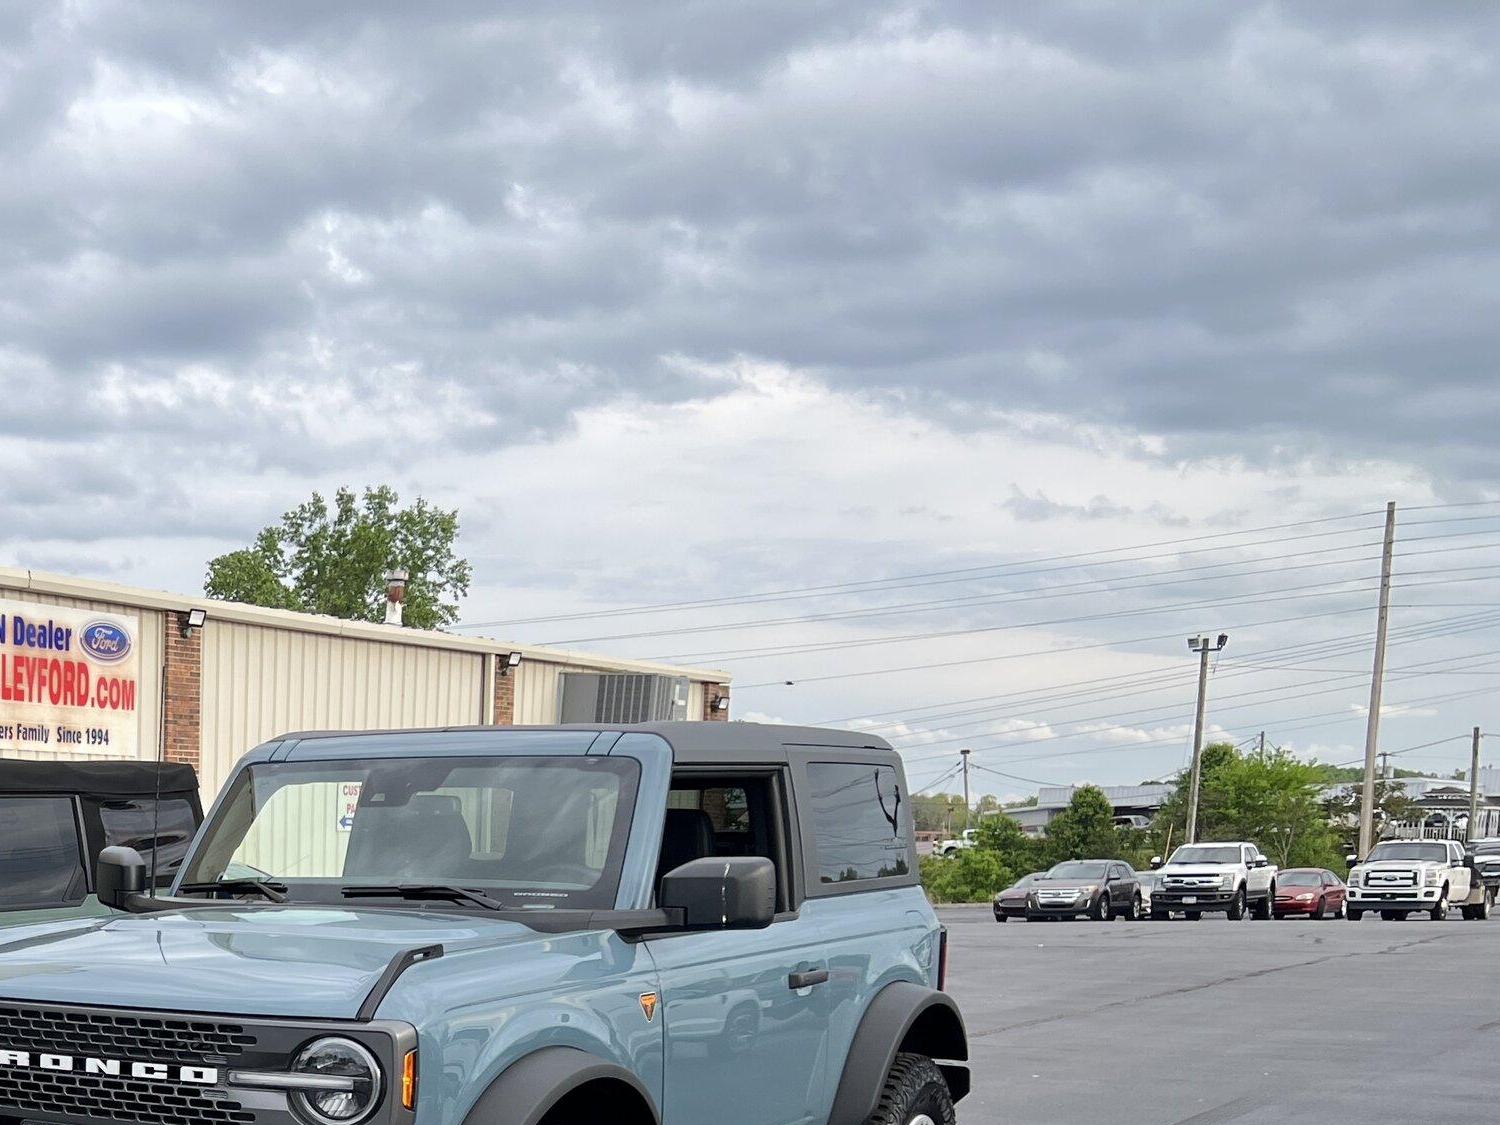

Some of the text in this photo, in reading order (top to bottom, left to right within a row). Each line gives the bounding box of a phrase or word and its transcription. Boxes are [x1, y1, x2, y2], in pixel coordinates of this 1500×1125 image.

[13, 616, 73, 651] Dealer
[91, 627, 119, 652] Ford
[16, 723, 50, 744] Family
[56, 726, 82, 744] Since
[85, 728, 110, 745] 1994
